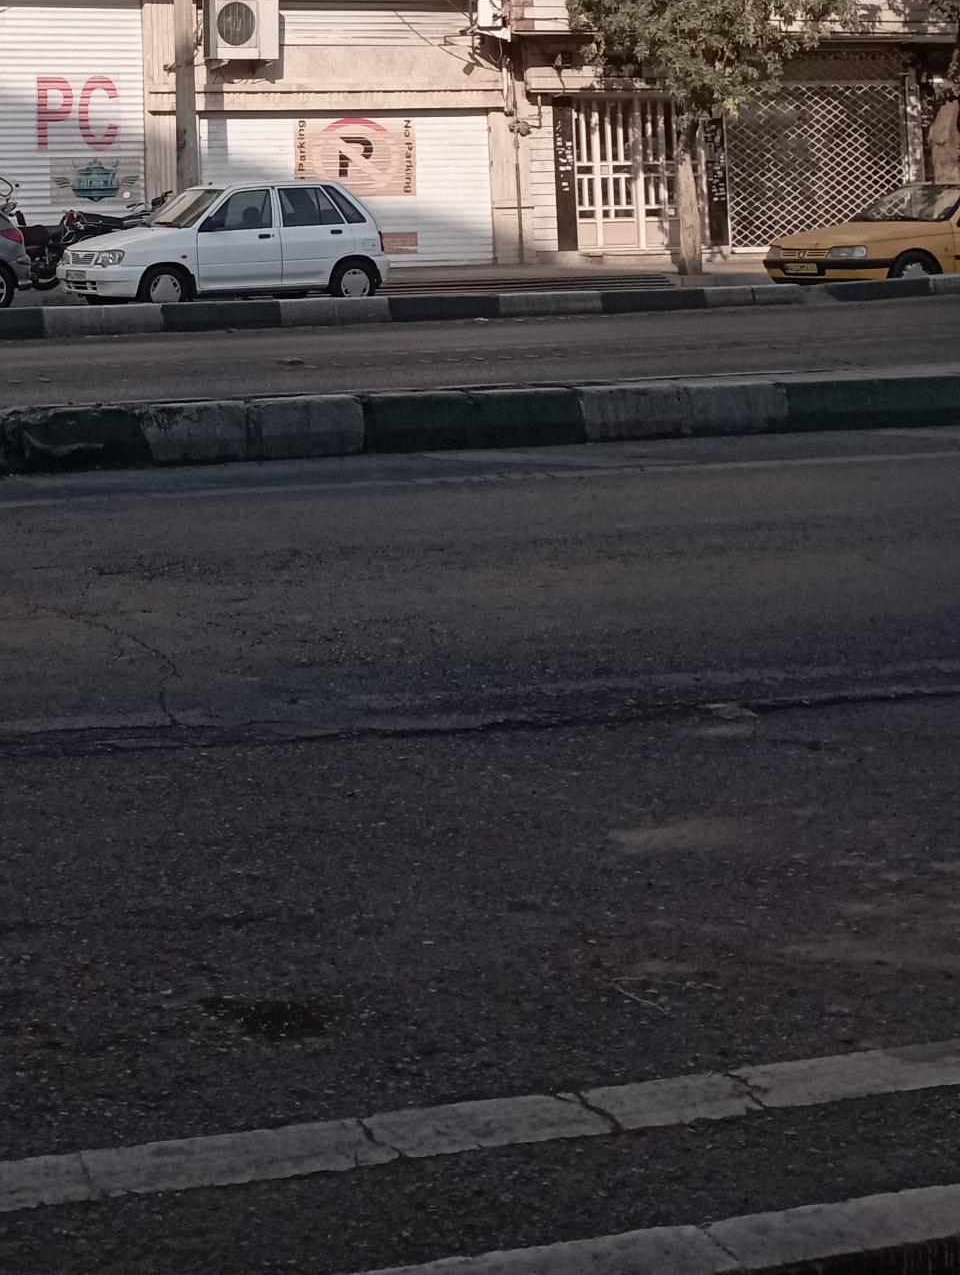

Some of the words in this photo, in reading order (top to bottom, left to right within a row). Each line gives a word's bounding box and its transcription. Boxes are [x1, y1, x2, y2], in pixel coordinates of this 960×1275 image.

[37, 75, 119, 150] PC
[403, 119, 412, 138] No
[403, 142, 414, 194] Parking
